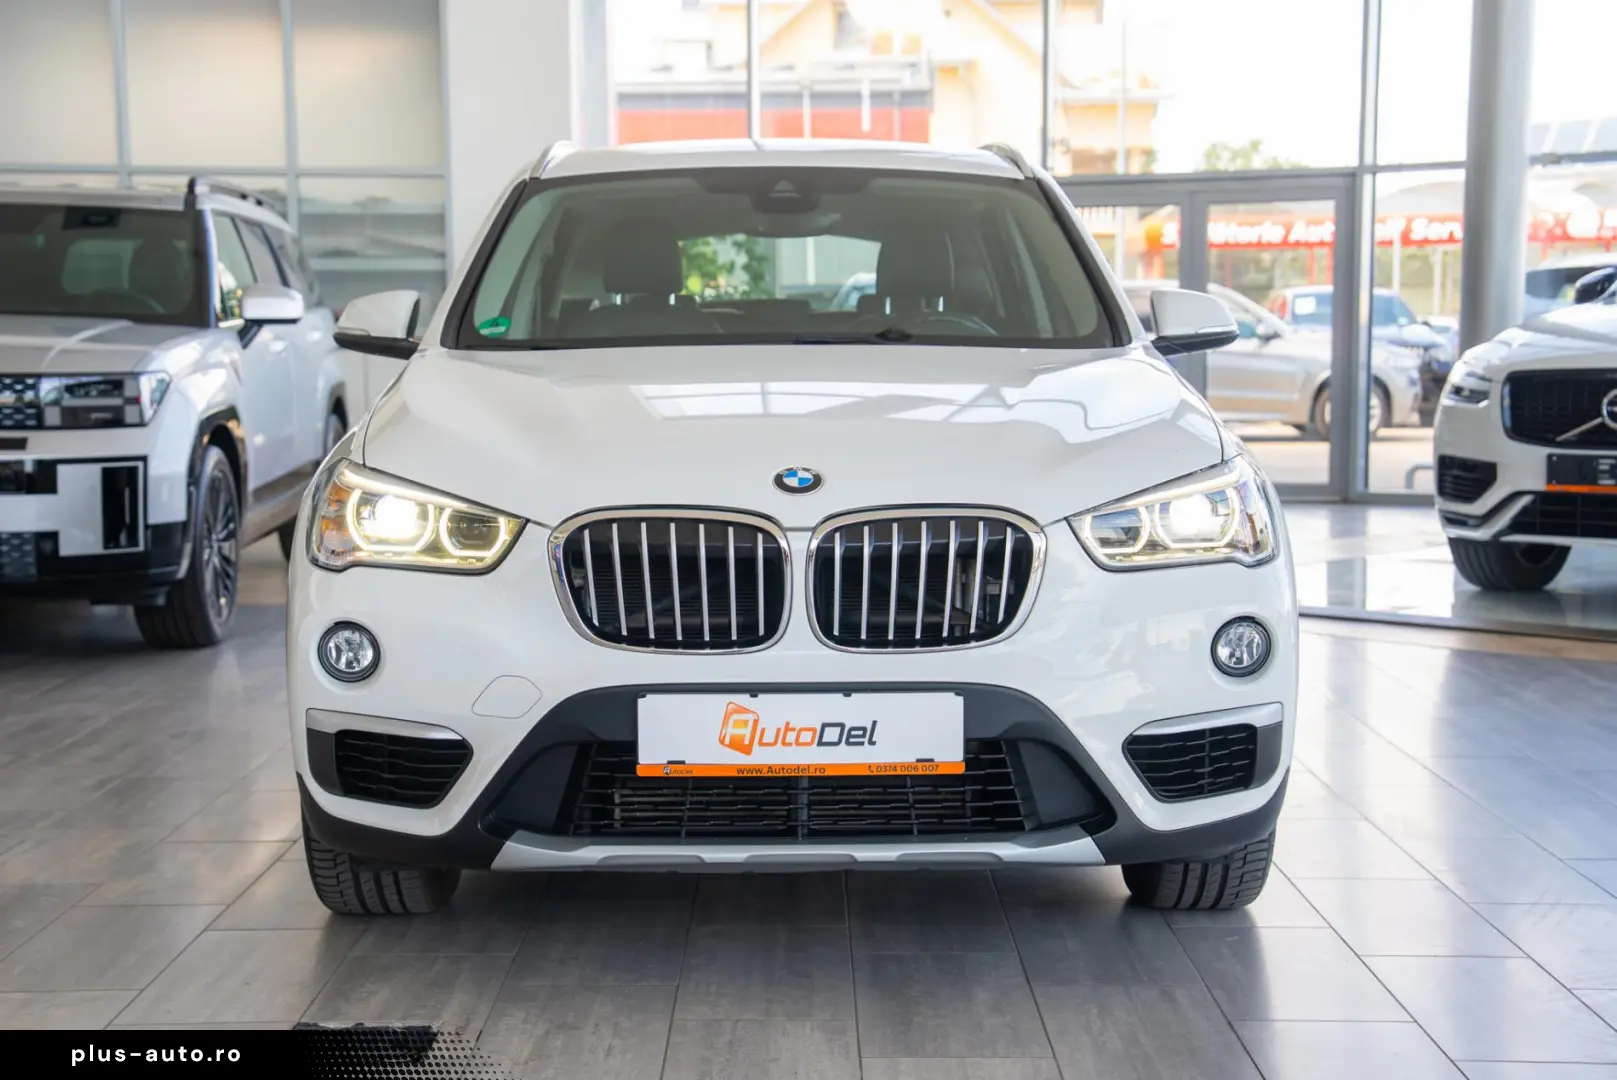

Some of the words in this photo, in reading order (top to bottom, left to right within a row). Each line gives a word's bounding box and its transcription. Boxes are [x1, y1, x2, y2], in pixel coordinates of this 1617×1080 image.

[724, 712, 878, 748] AutoDel
[736, 765, 826, 775] www.Autodel.ro
[876, 765, 898, 773] 0374
[921, 764, 939, 772] 007
